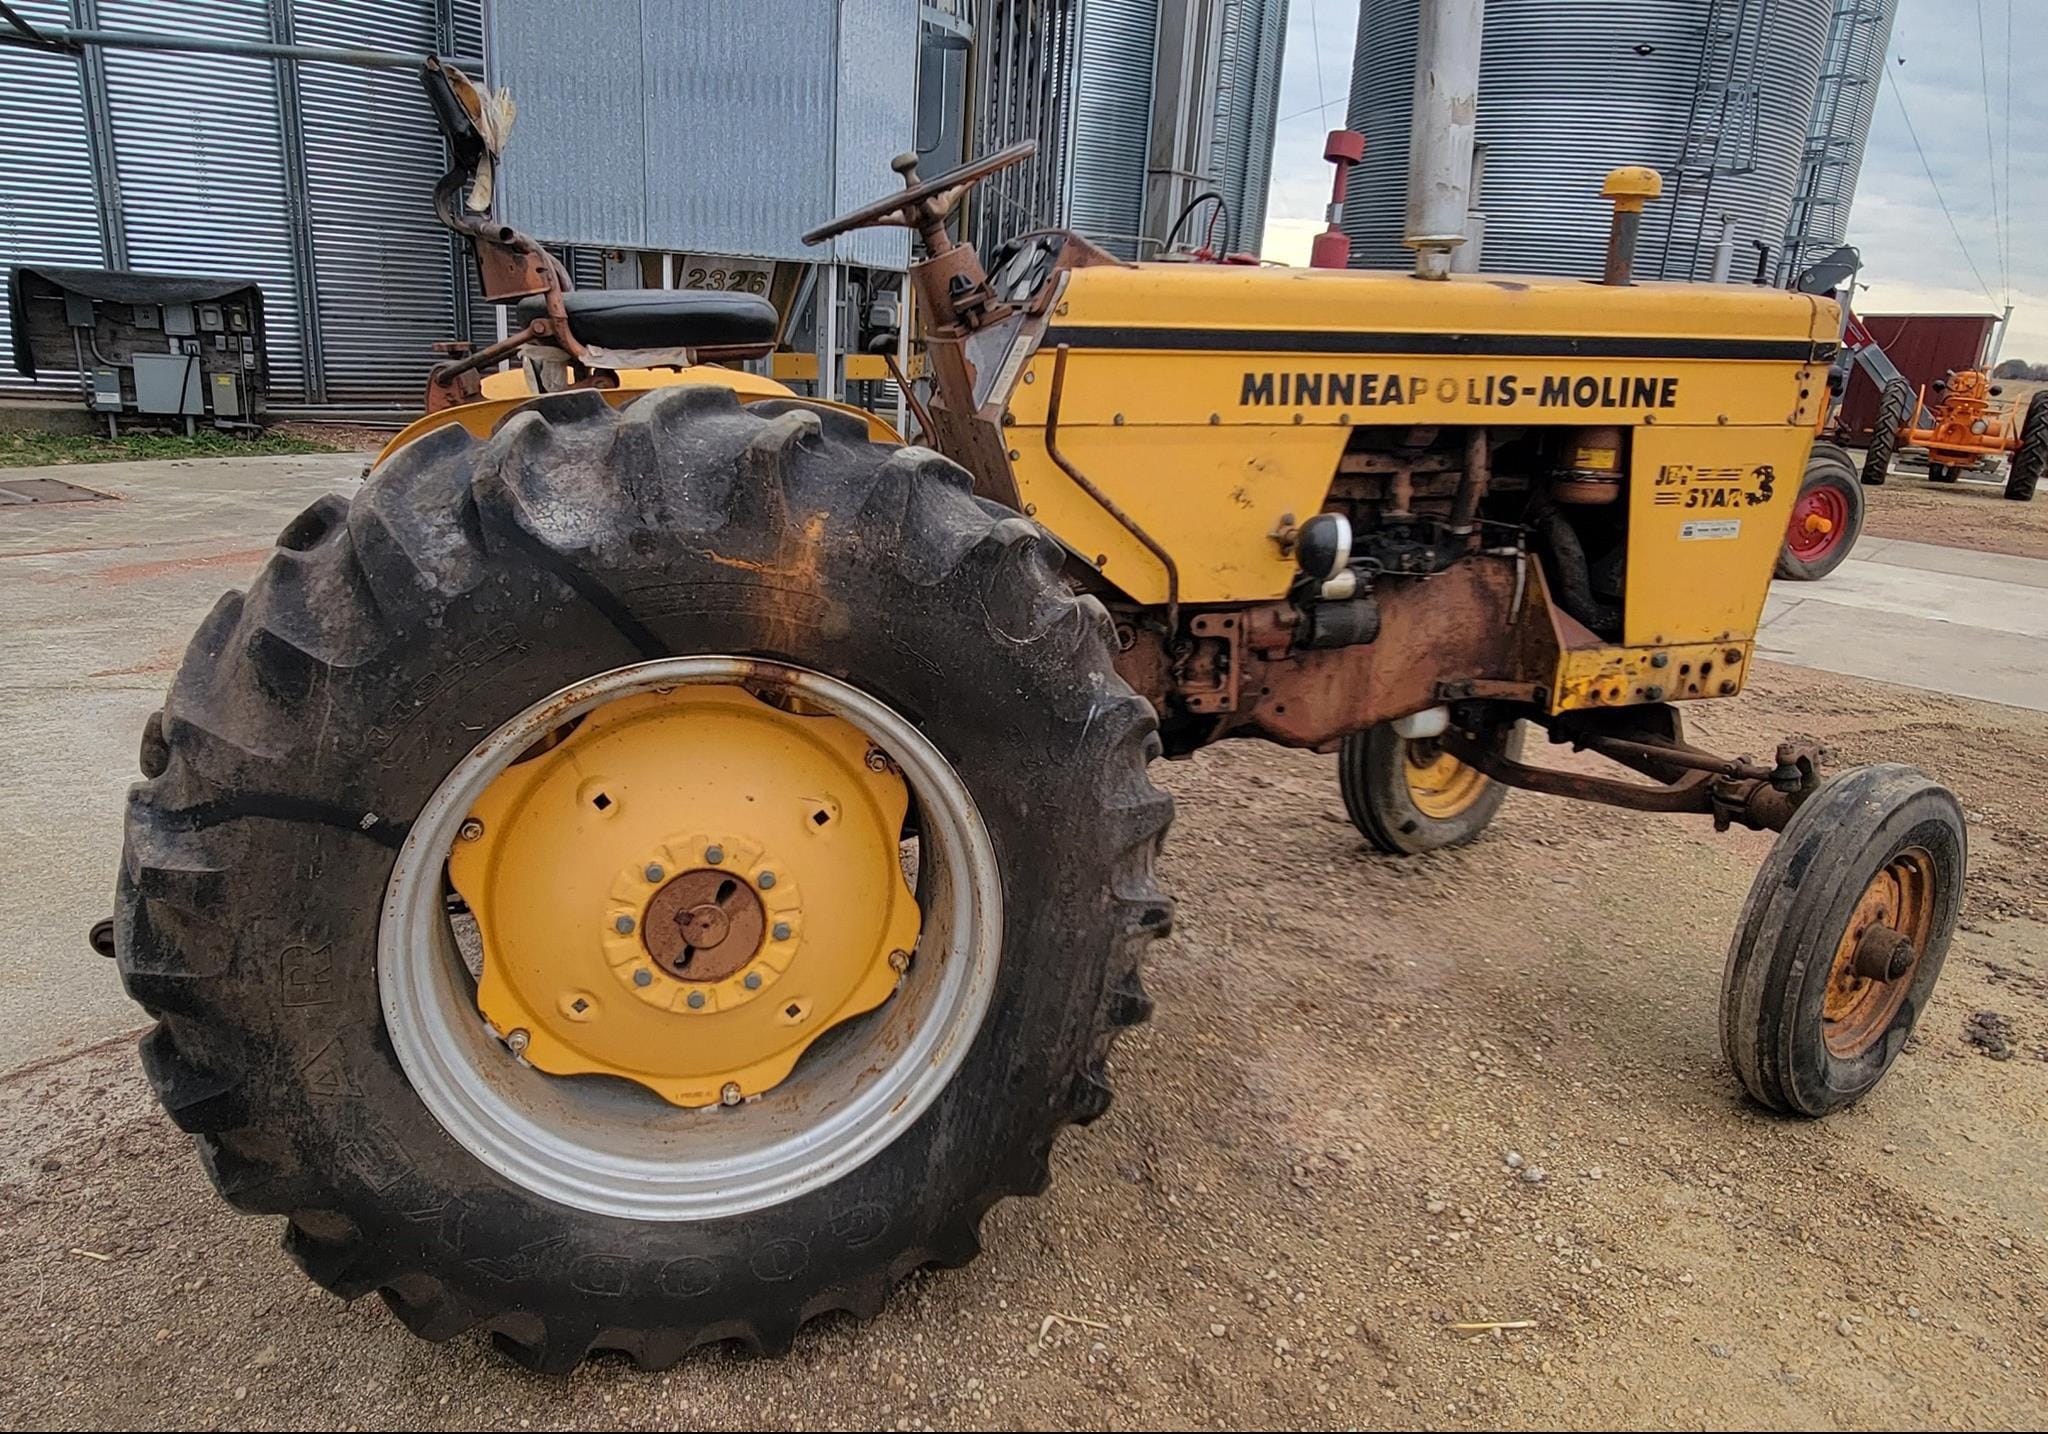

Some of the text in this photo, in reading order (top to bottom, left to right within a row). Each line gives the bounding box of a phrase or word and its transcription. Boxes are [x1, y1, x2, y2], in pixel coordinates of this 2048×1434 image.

[686, 268, 768, 295] 2326
[1240, 372, 1679, 409] MINNEAPOLIS-MOLINE
[1744, 464, 1776, 506] 3
